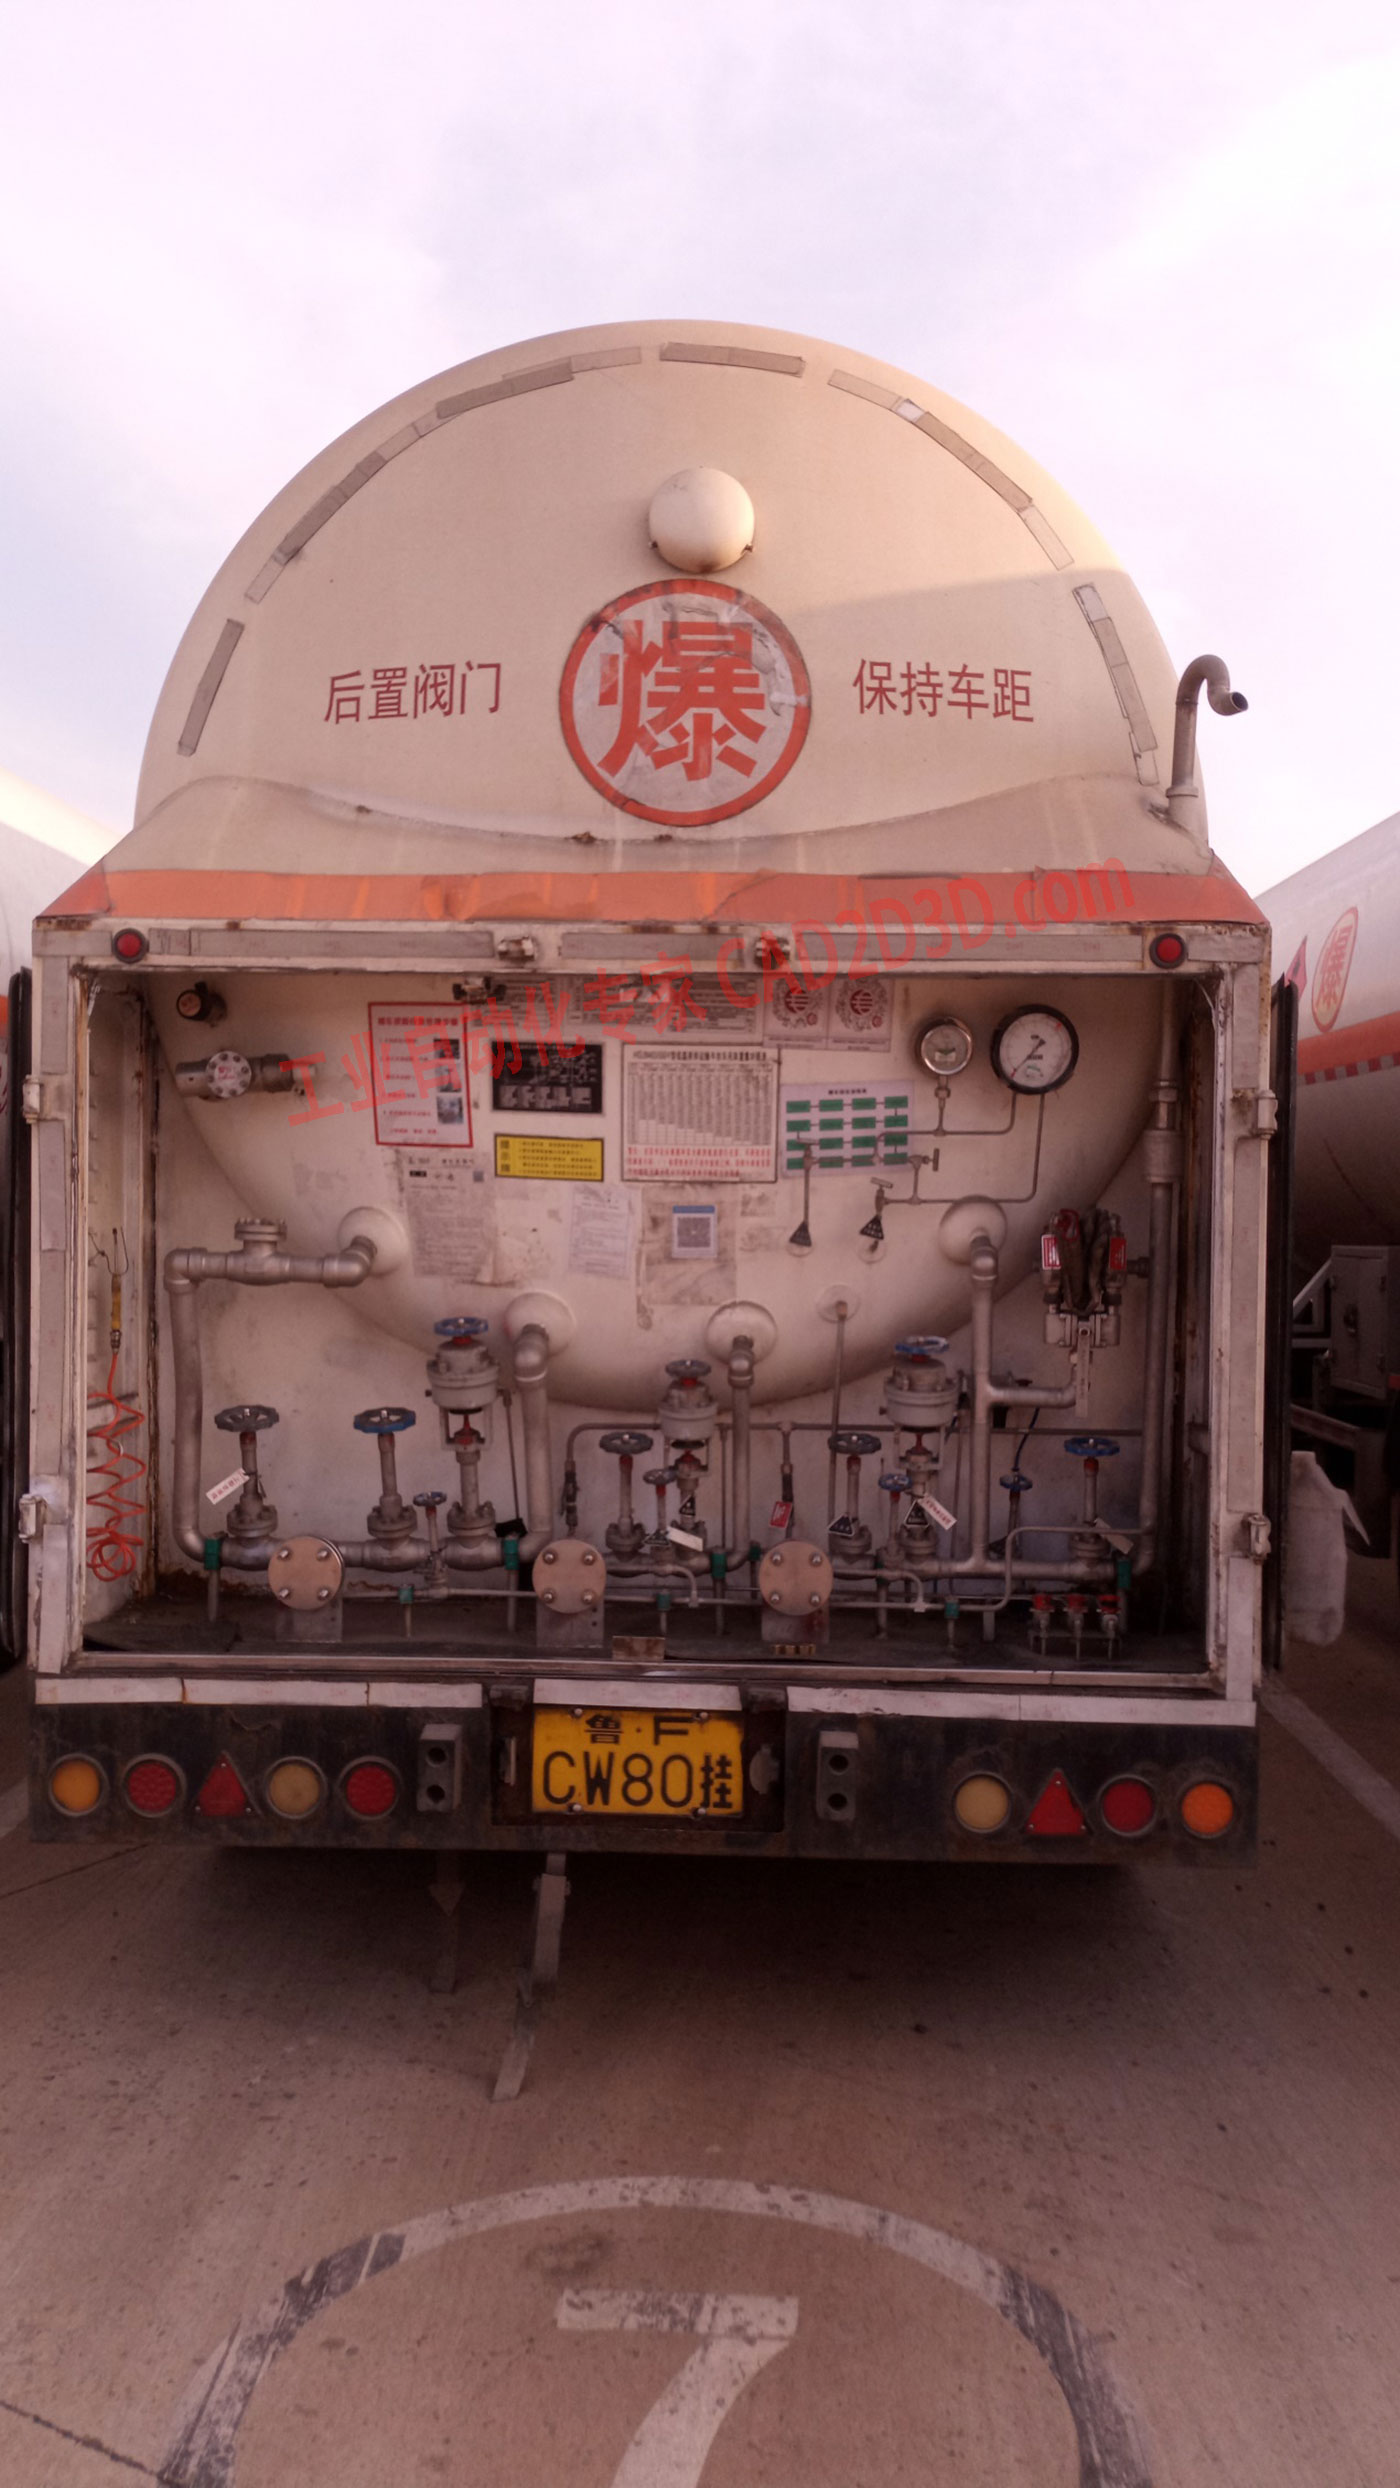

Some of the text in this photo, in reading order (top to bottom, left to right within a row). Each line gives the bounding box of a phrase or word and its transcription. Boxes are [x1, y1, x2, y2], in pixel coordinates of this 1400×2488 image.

[324, 660, 502, 725] 后置阀门
[596, 618, 767, 782] 爆
[852, 658, 1035, 723] 保持车距
[543, 1751, 733, 1809] CW80挂
